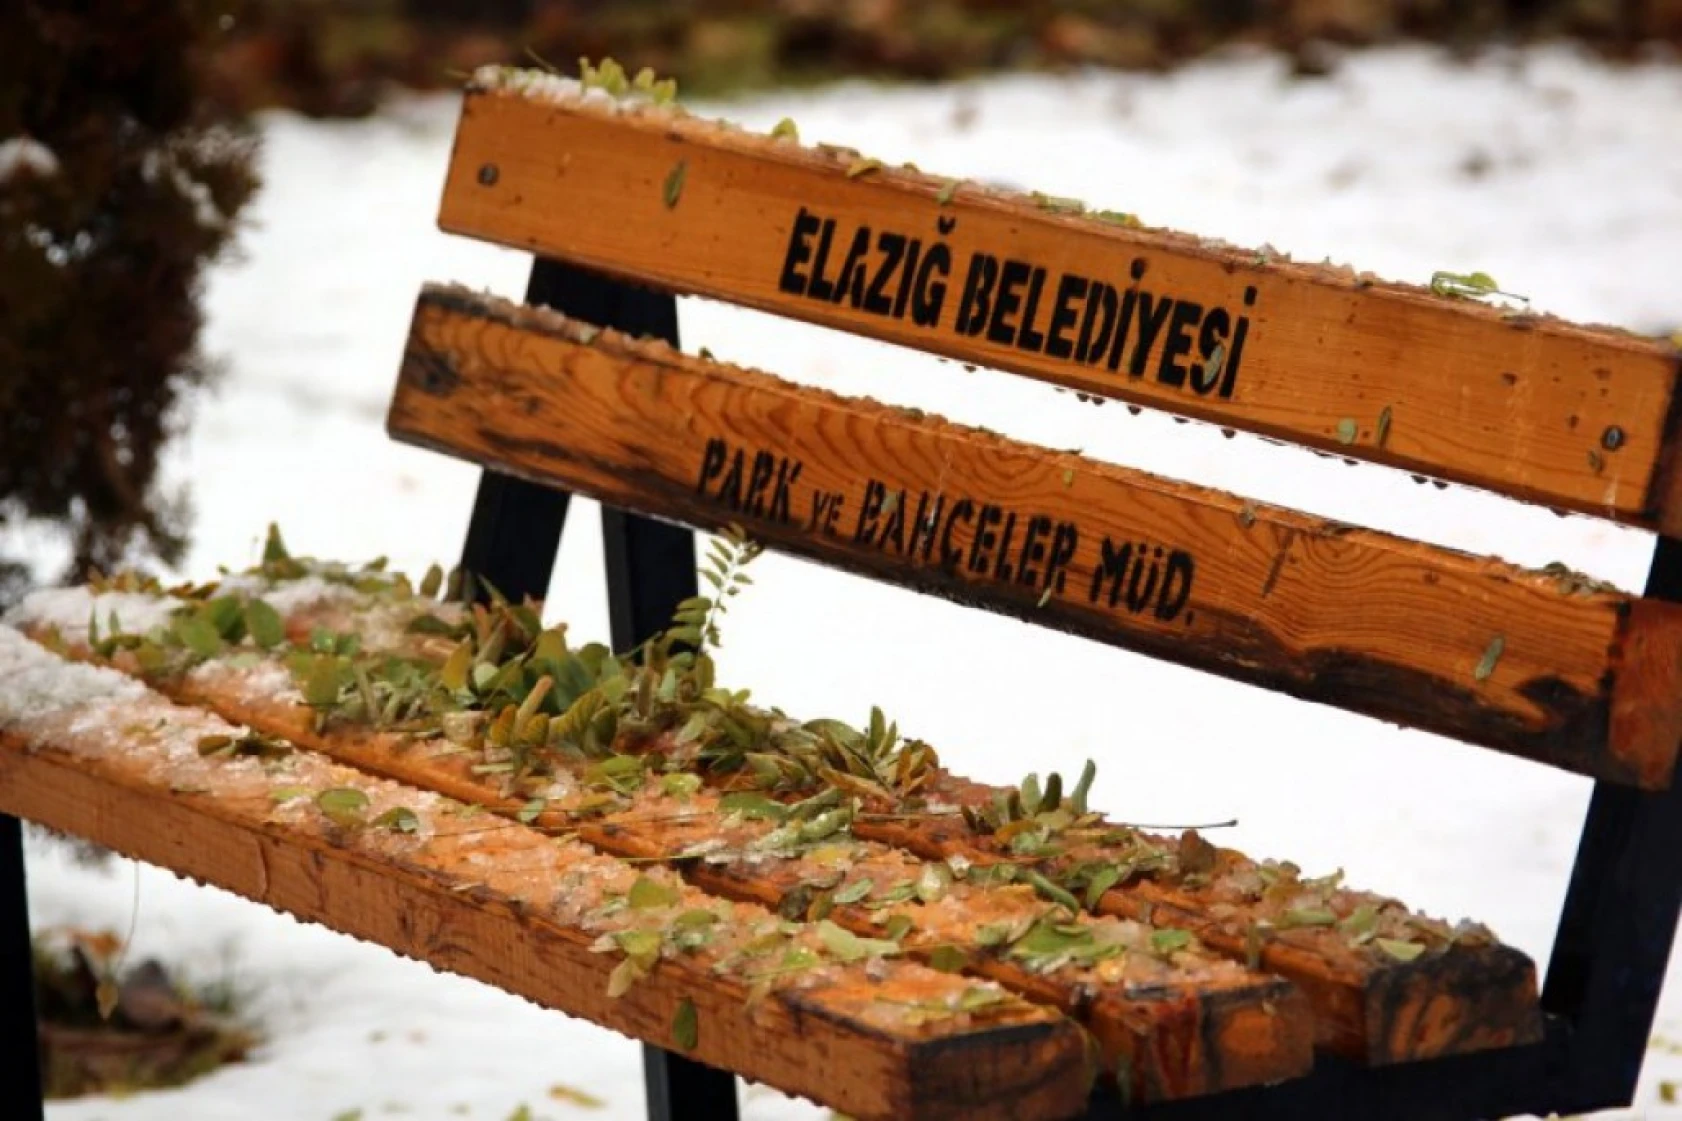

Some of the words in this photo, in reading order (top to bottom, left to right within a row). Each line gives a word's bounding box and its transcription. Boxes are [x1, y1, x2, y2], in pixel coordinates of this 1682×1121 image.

[779, 207, 955, 328] ELAZIĞ
[955, 252, 1258, 398] BELEDİYESİ
[698, 437, 803, 525] PARK
[1089, 535, 1195, 626] MÜD.
